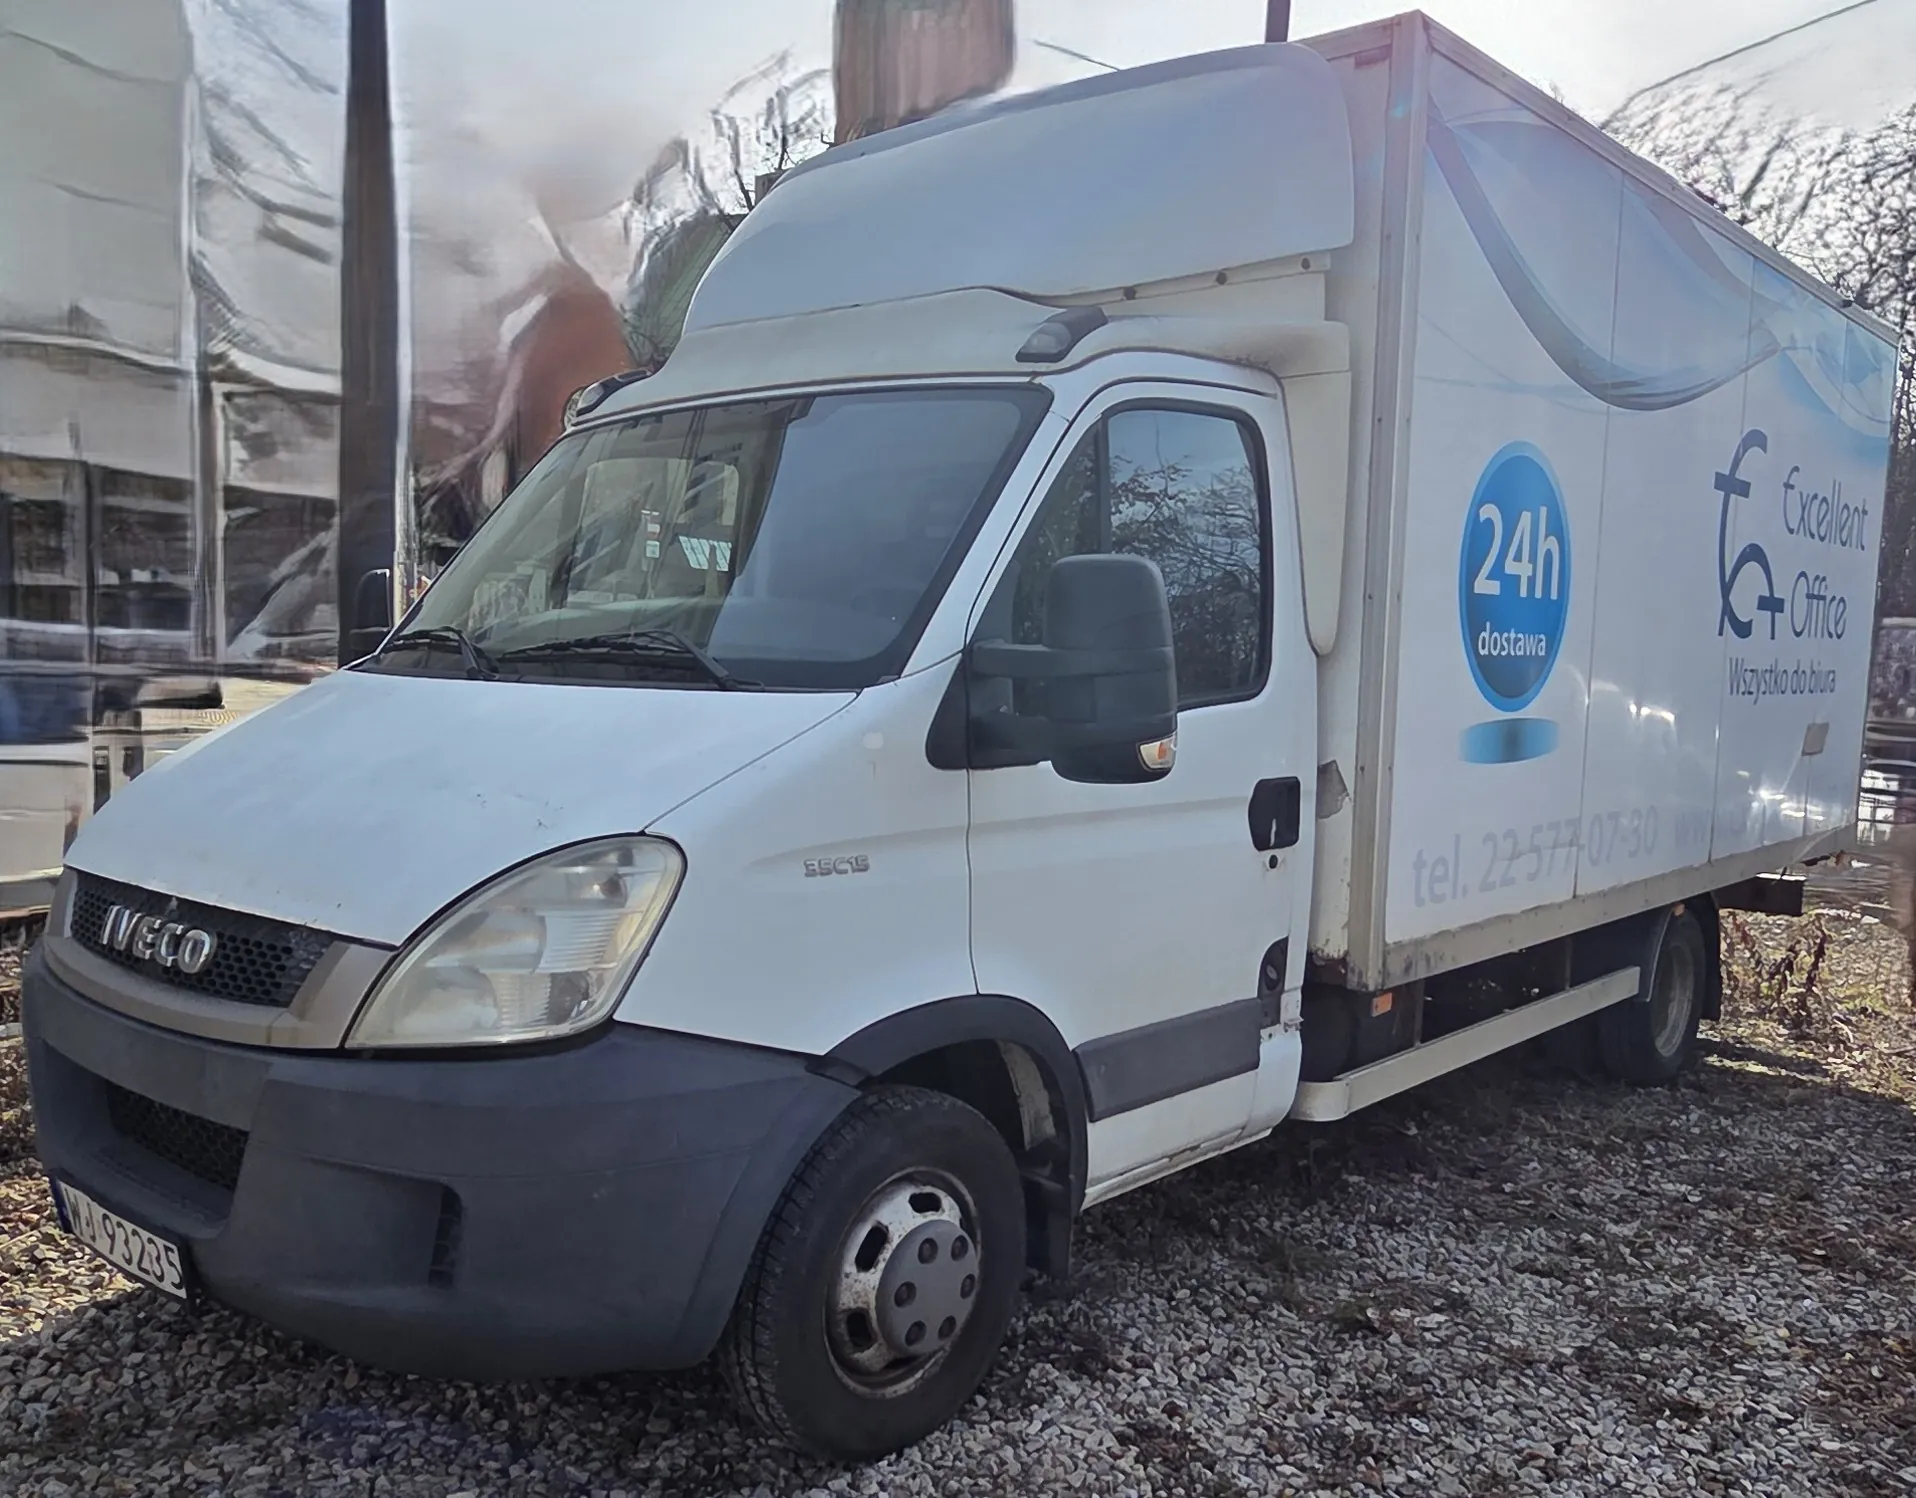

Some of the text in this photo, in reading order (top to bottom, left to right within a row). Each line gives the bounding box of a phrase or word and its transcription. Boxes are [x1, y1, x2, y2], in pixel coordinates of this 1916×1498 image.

[1782, 465, 1869, 551] Excellent
[1473, 503, 1560, 600] 24h
[1477, 621, 1547, 656] dostawa
[1790, 570, 1848, 640] Office
[1728, 657, 1836, 705] Wszystko do biura
[803, 854, 870, 878] 35C15
[1412, 833, 1469, 907] tel.
[101, 904, 217, 974] IVECO
[64, 1187, 184, 1290] WJ 93235
